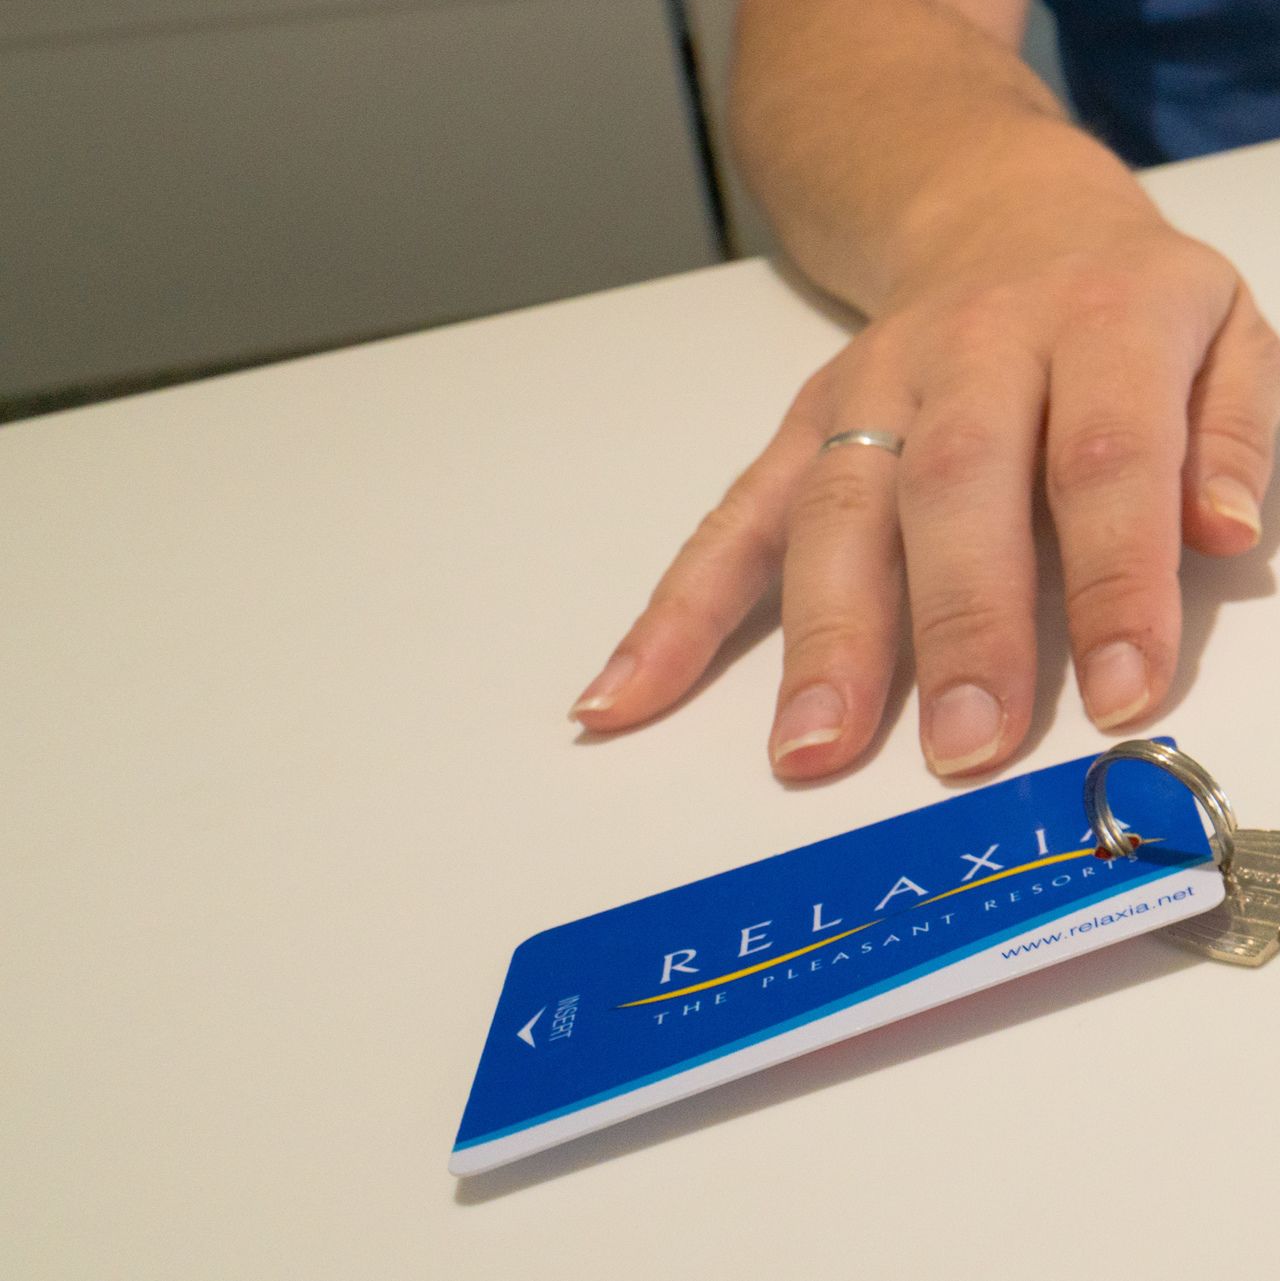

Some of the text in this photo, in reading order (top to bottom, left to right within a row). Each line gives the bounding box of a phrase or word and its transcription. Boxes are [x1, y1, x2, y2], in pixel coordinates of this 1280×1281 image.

[654, 851, 1139, 1025] THE PLEASANT RESORTS
[1001, 885, 1196, 960] www.relaxia.net
[548, 994, 580, 1041] INSERT
